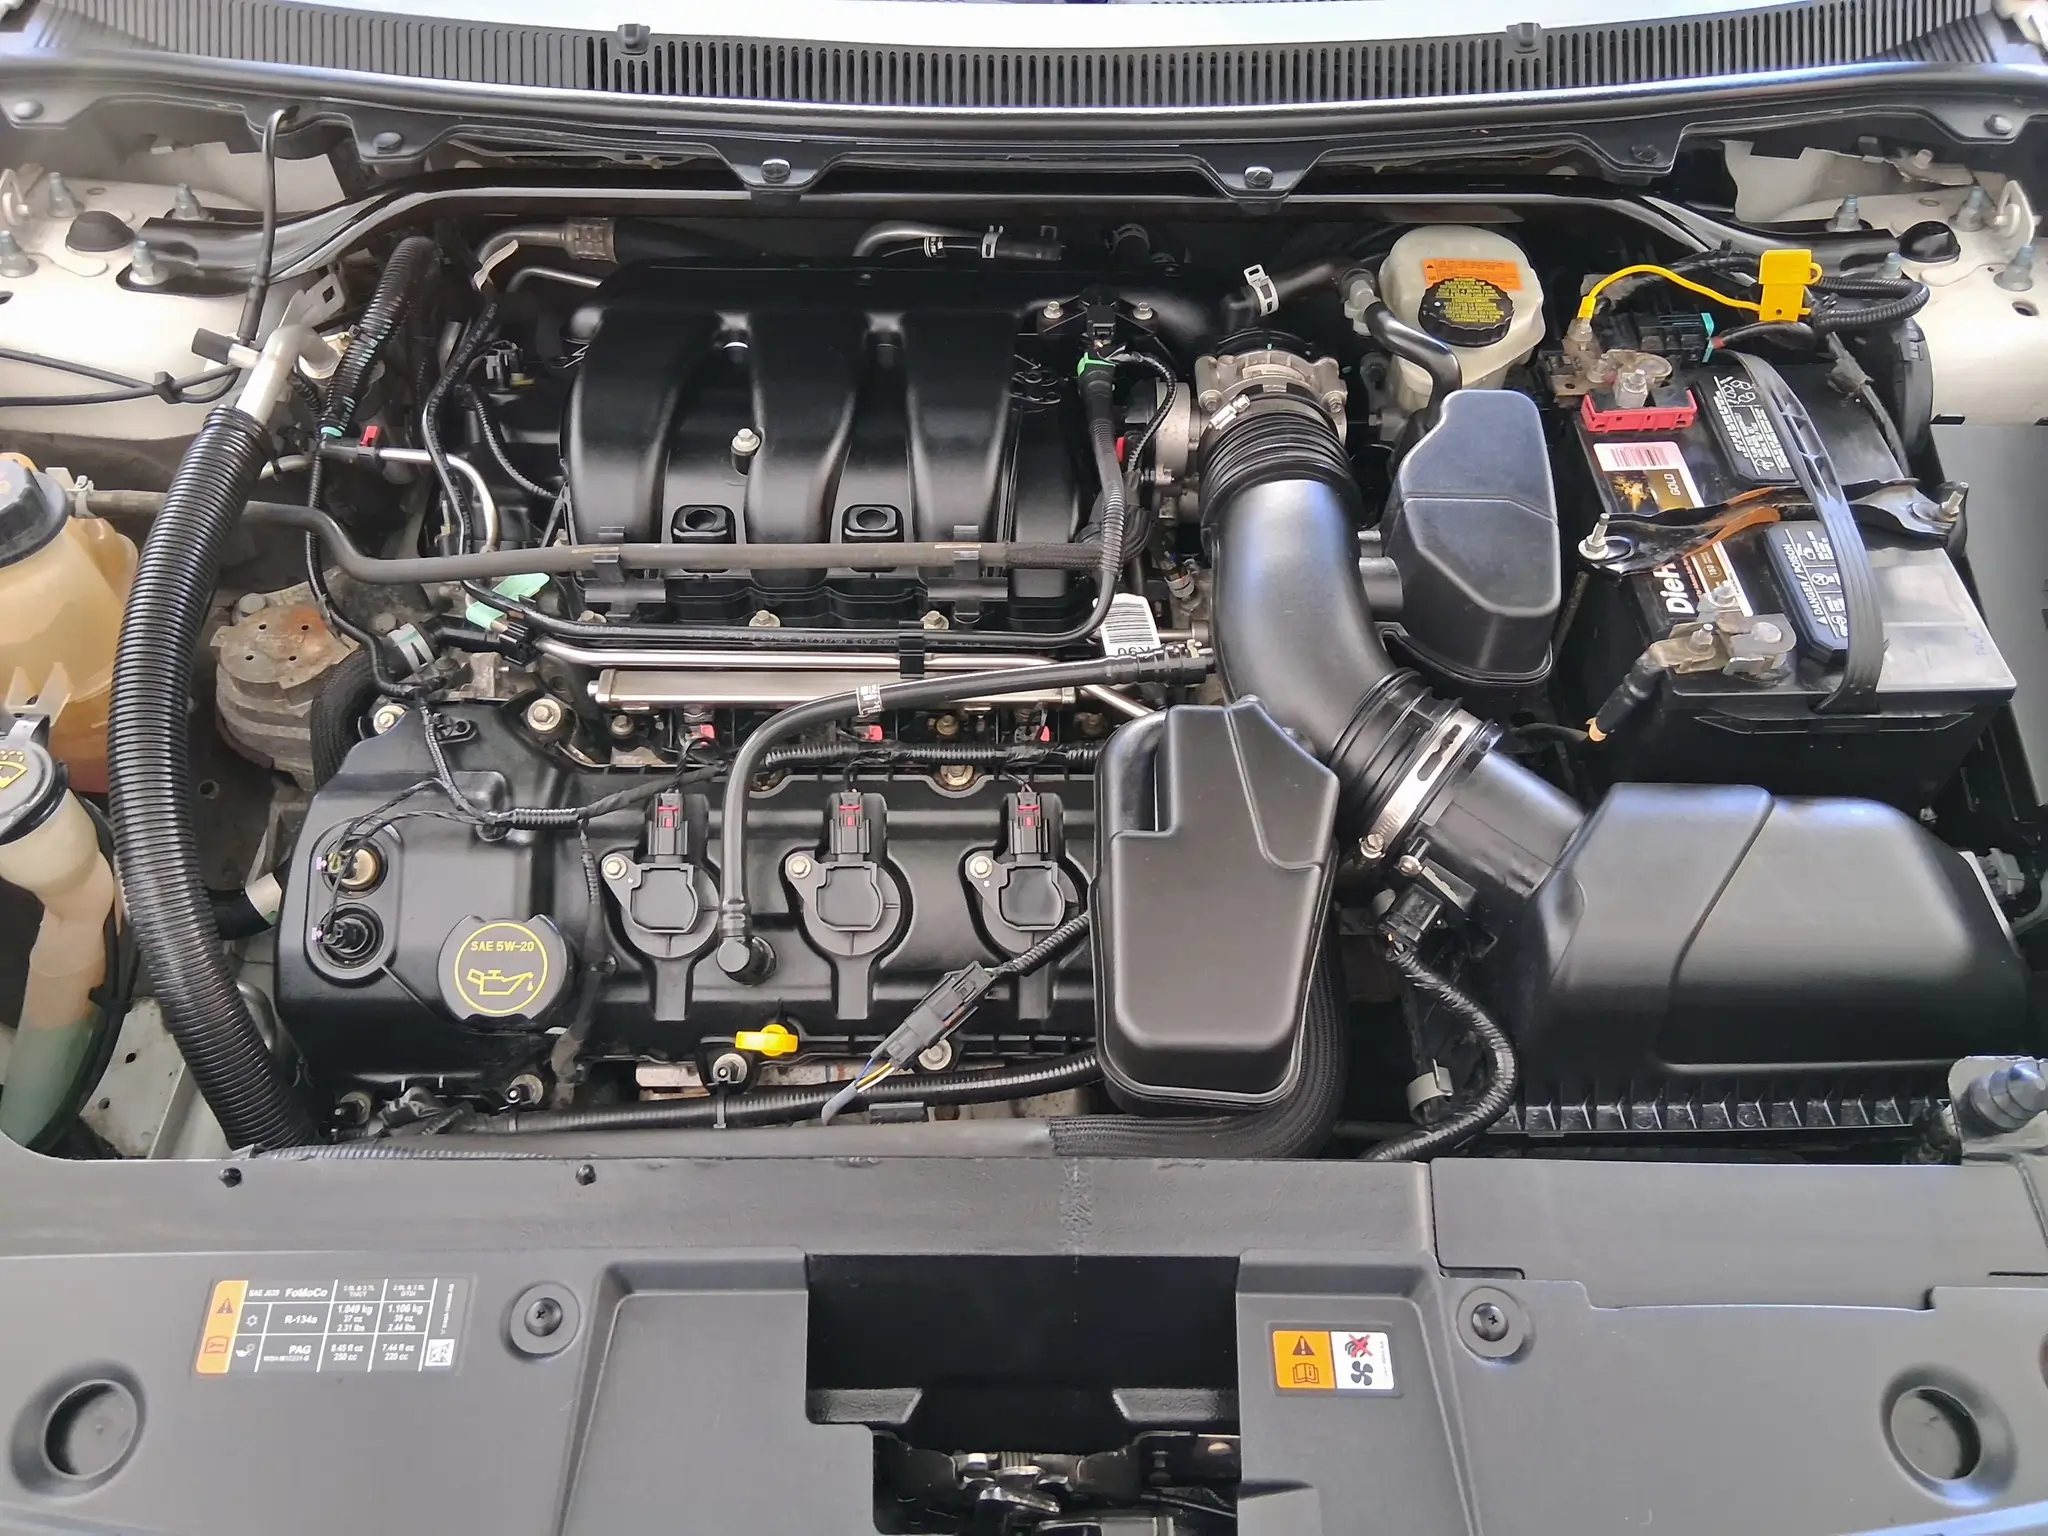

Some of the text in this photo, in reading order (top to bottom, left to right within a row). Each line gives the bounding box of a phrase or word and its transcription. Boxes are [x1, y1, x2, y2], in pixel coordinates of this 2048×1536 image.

[1664, 473, 1681, 496] GOLD
[1782, 543, 1805, 574] POISON
[1800, 581, 1825, 616] DANGER
[470, 940, 535, 952] SAE 5W-20
[285, 1287, 329, 1298] FoMoCo
[361, 1305, 374, 1316] kg
[411, 1304, 424, 1316] kg
[284, 1315, 319, 1324] R-134a
[288, 1344, 312, 1355] PAG
